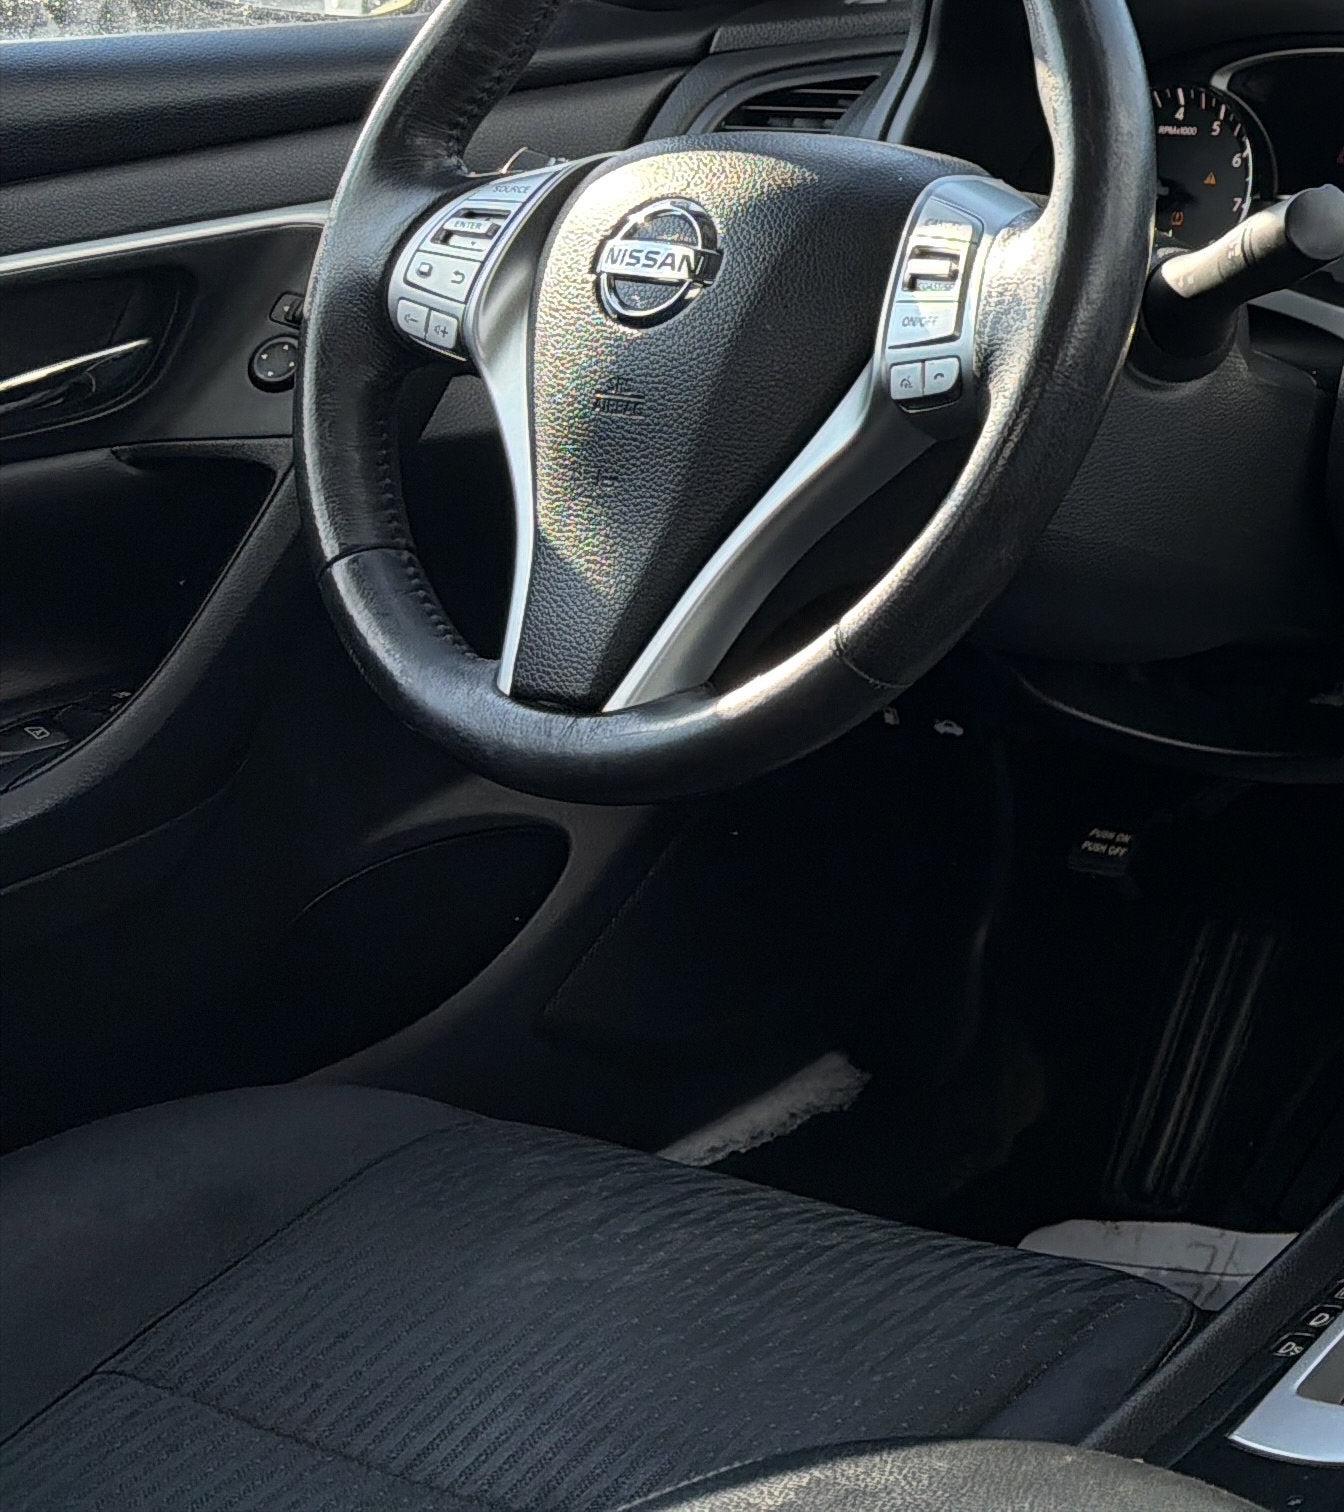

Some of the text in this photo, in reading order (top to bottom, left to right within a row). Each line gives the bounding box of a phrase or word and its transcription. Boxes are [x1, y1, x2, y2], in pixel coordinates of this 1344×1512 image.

[1175, 106, 1185, 121] 4
[1210, 121, 1221, 136] 5
[1232, 153, 1242, 168] 6
[492, 184, 530, 194] SOURCE
[1233, 198, 1242, 212] 7
[453, 220, 483, 231] ENTER
[604, 246, 699, 273] NISSAN
[1308, 1312, 1330, 1328] D
